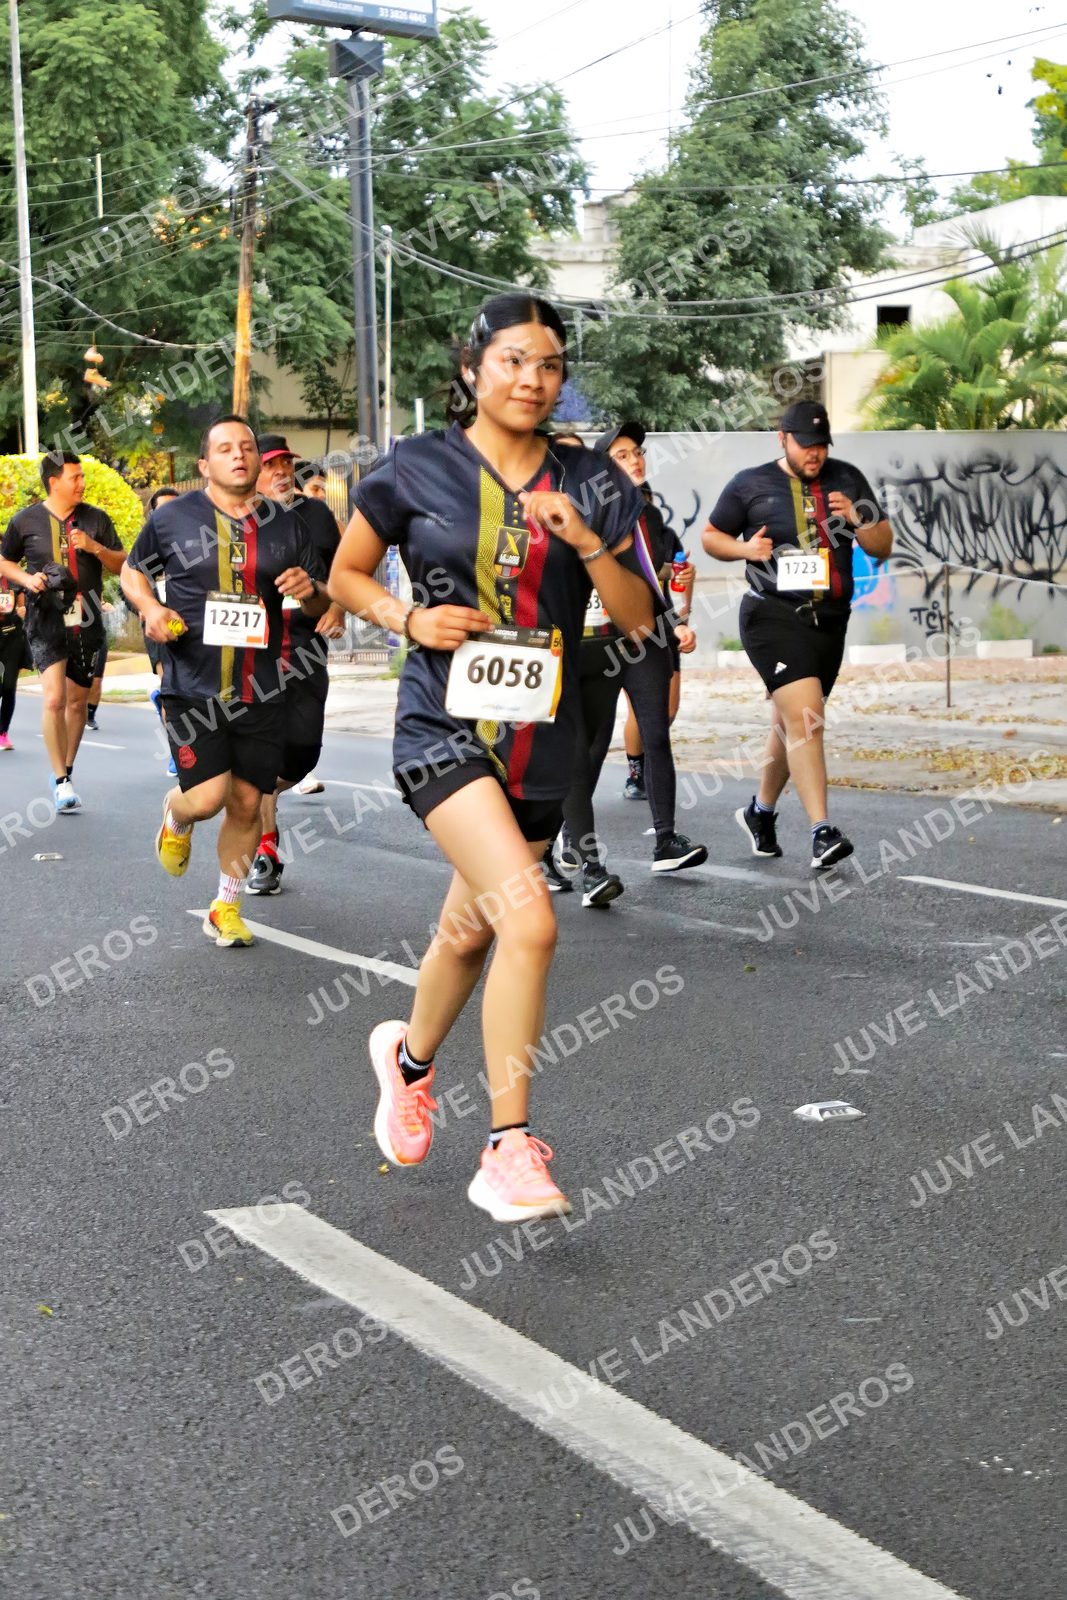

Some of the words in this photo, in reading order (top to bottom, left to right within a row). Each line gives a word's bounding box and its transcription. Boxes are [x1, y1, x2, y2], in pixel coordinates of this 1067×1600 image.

[785, 561, 817, 575] 1723
[210, 609, 262, 628] 12217
[467, 654, 544, 689] 6058
